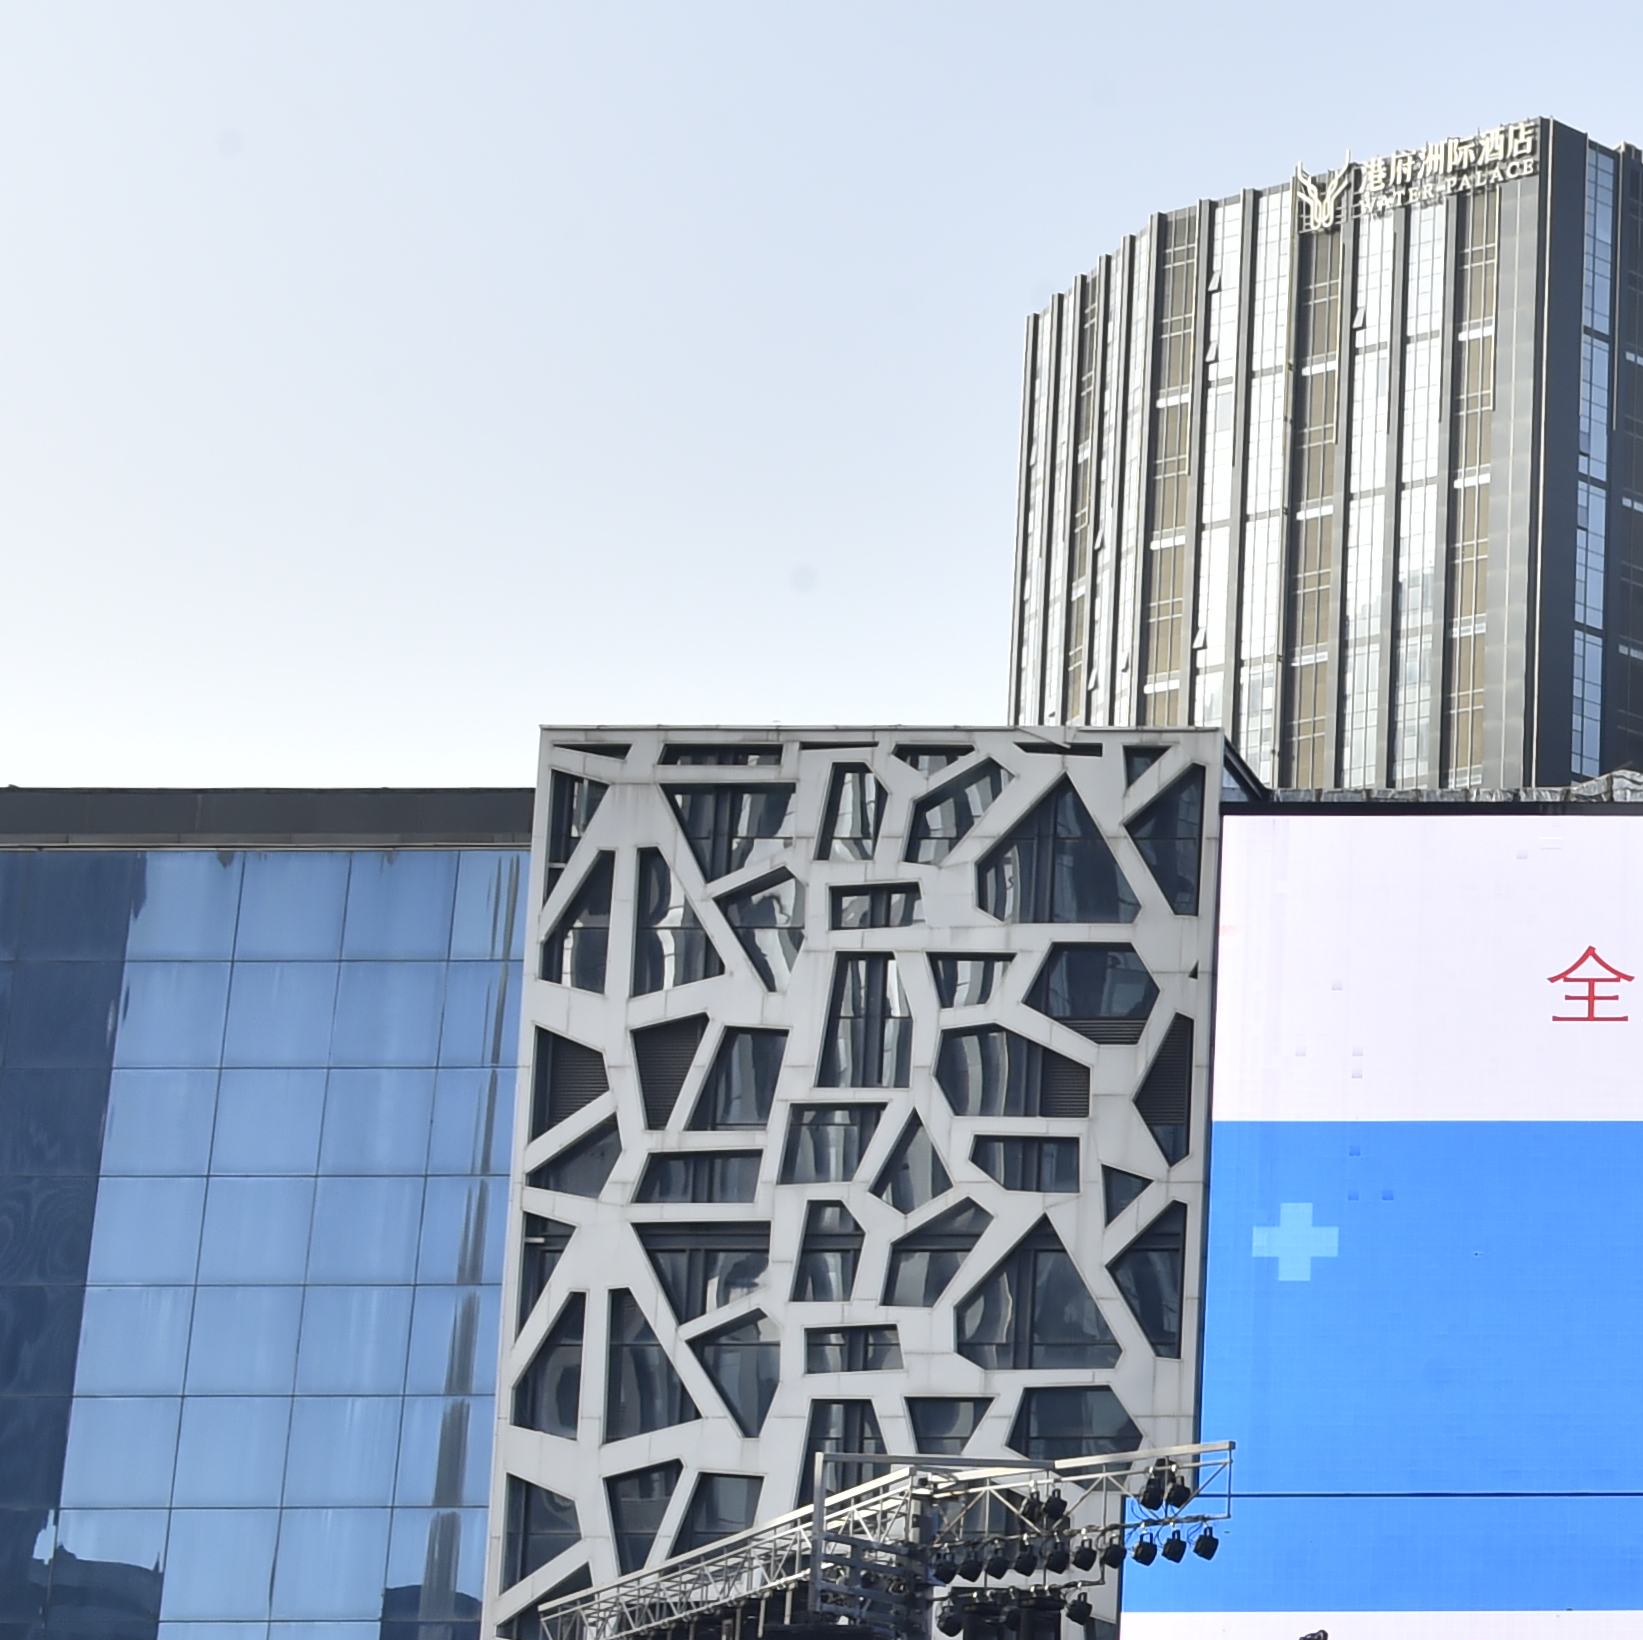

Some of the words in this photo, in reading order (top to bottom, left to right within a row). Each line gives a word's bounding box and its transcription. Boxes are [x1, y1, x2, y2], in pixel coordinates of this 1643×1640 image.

[1358, 122, 1536, 193] 港府洲际酒店
[1359, 184, 1435, 214] WATER
[1444, 159, 1536, 192] PALACE
